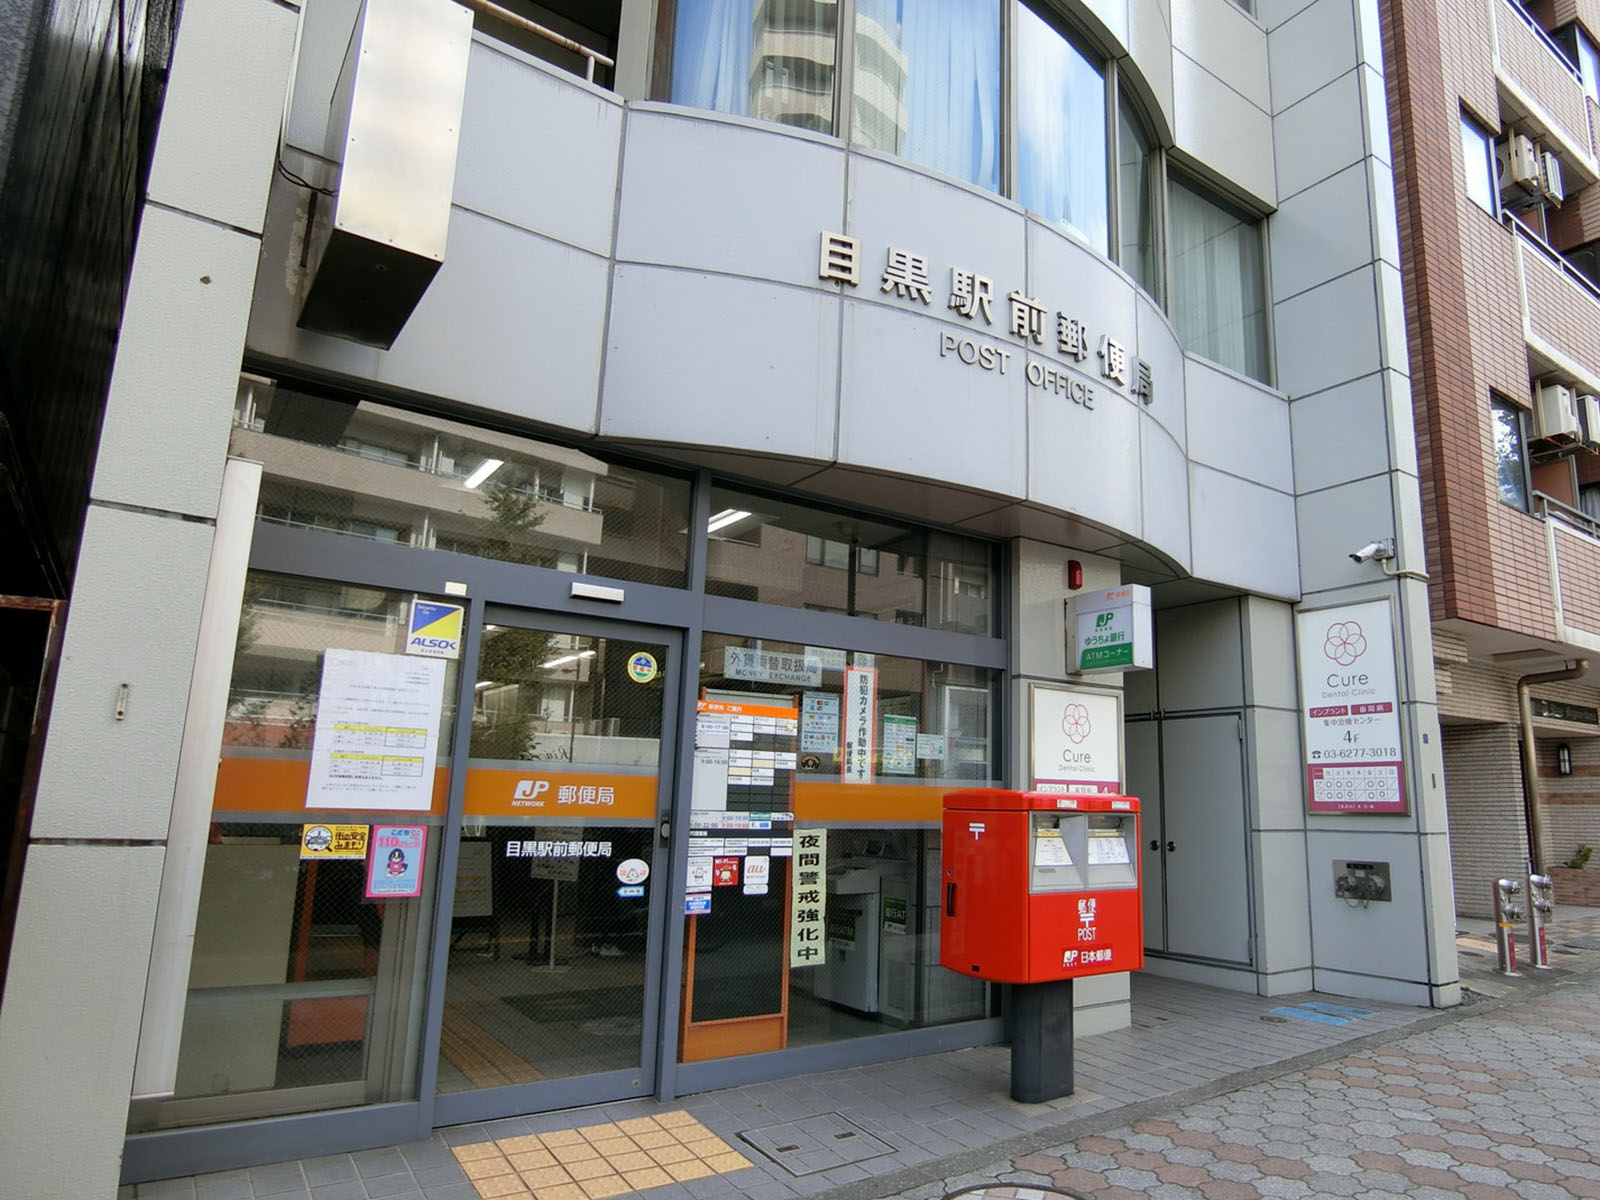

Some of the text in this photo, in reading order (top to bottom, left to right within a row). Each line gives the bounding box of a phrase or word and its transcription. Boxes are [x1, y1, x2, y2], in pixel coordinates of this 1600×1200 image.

[819, 230, 1154, 405] 目黒駅前郵便局
[940, 331, 1095, 410] POST OFFICE
[411, 637, 456, 650] ALSOK
[1085, 631, 1125, 646] ゆうちょ銀行
[735, 668, 811, 682] MONEY EXCHANGE
[1327, 674, 1368, 688] Cure
[1322, 688, 1376, 699] Dental Clinic
[857, 674, 869, 779] 防犯カメラ作動中です
[1343, 730, 1360, 743] 4F
[1063, 749, 1091, 763] Cure
[1324, 747, 1396, 759] 03-6277-3018
[514, 780, 550, 800] JP
[558, 785, 615, 805] 郵便局
[506, 841, 612, 857] 目黒駅前郵便局
[747, 865, 765, 874] au
[797, 835, 820, 961] 夜間警戒強化中
[1078, 927, 1096, 941] POST
